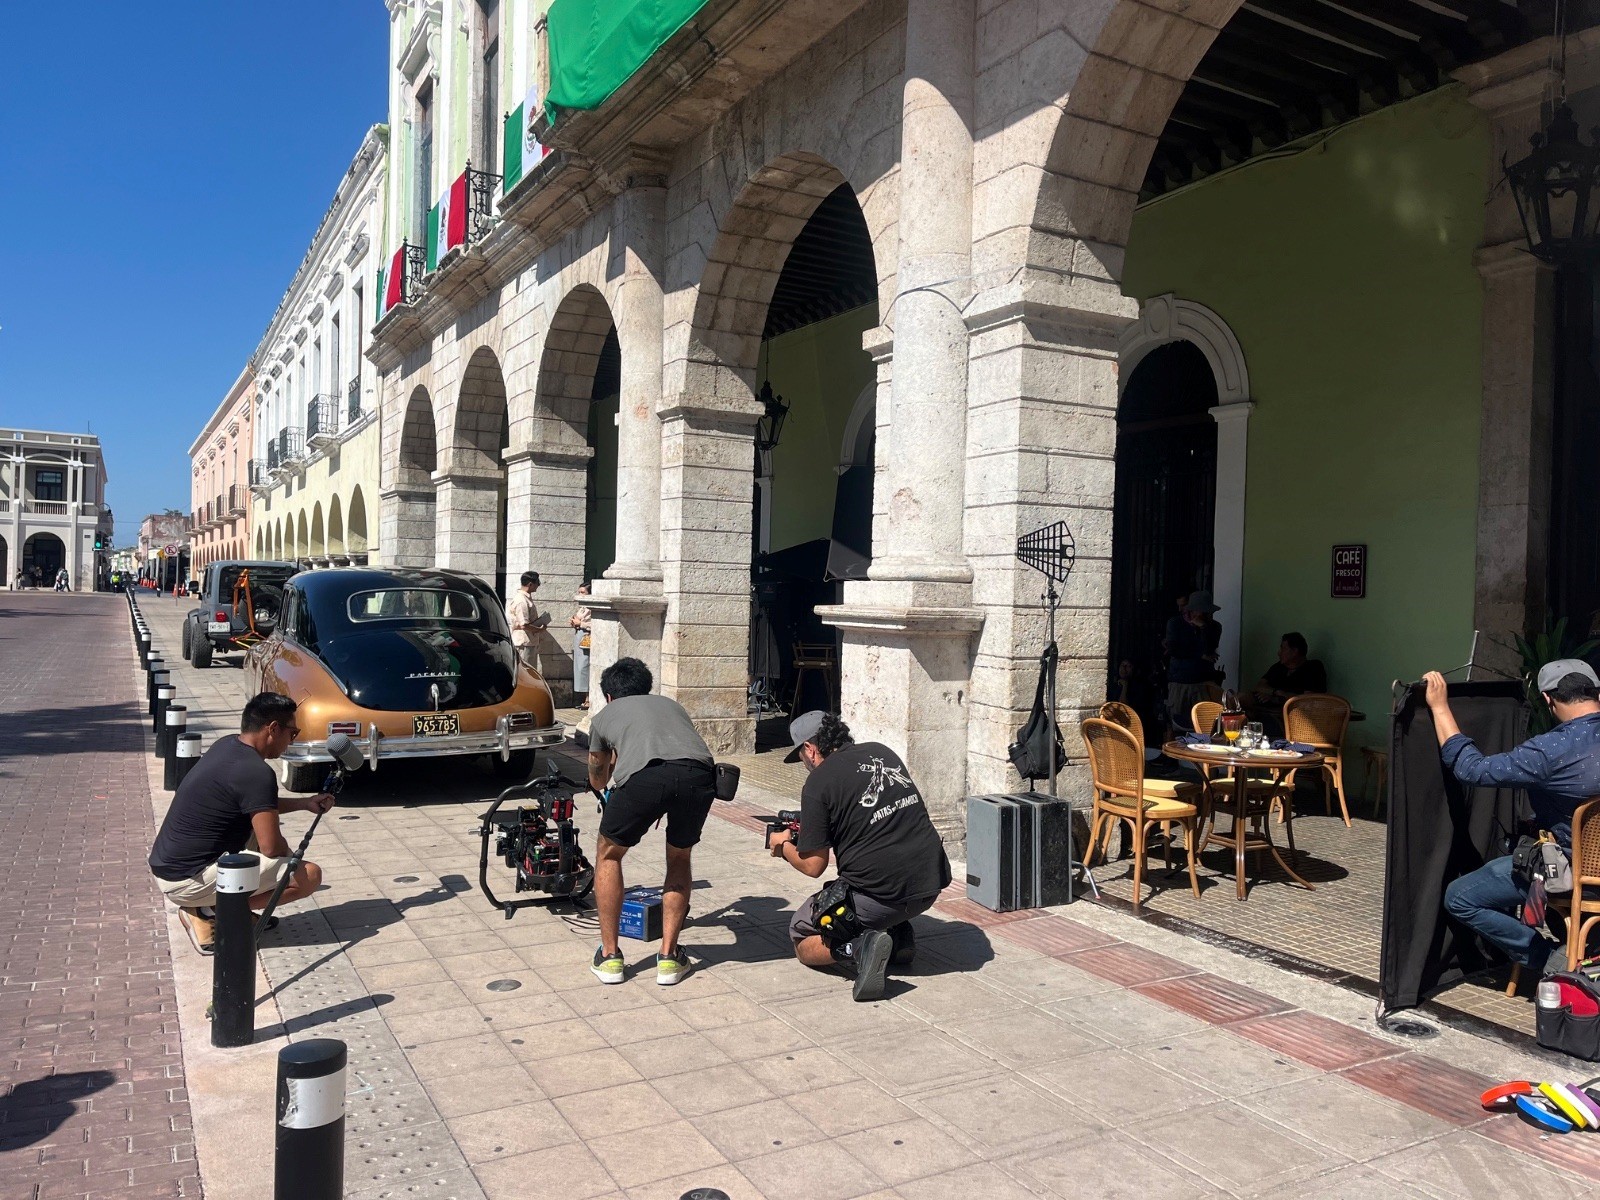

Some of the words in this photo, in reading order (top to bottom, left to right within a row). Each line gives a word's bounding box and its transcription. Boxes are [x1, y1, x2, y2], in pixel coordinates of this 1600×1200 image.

[1336, 548, 1360, 565] CAFÉ
[1336, 569, 1360, 577] FRESCO
[873, 805, 893, 822] PATAS
